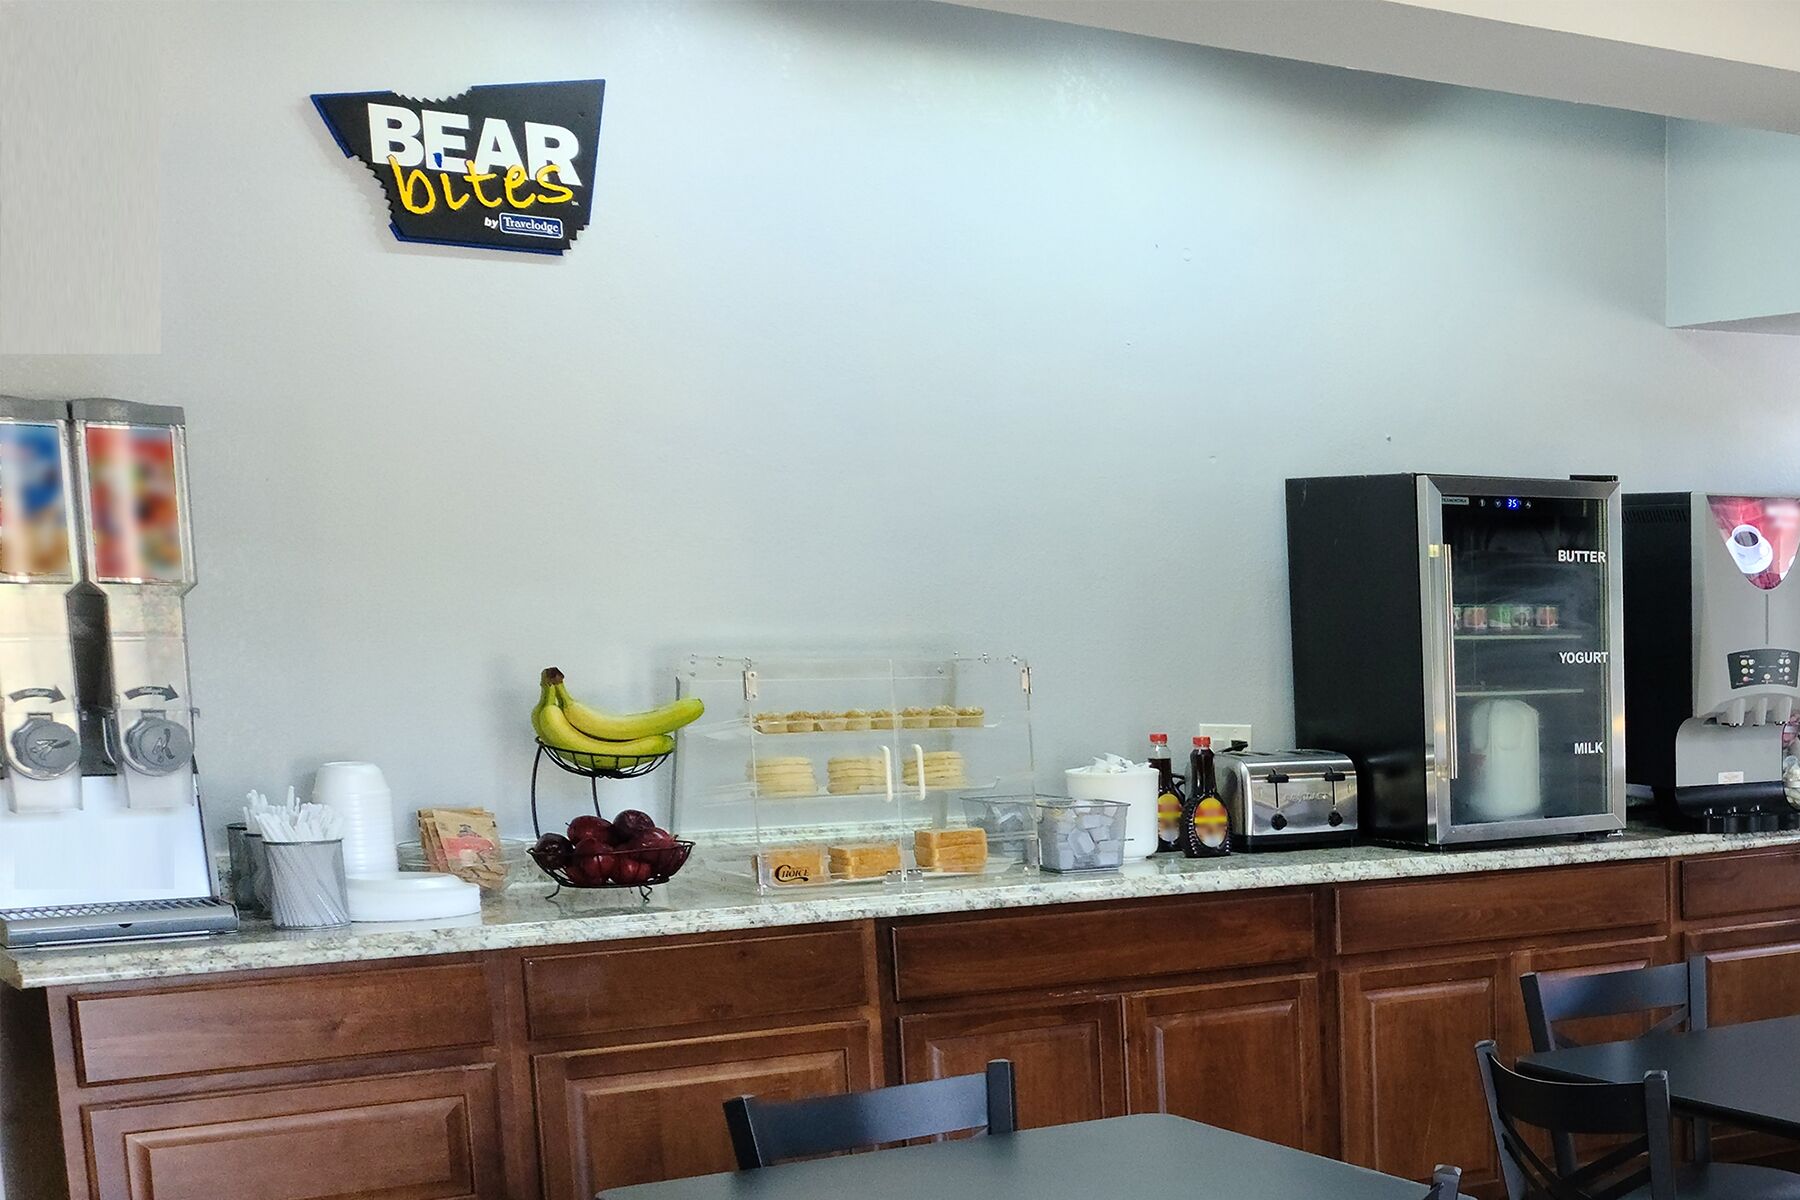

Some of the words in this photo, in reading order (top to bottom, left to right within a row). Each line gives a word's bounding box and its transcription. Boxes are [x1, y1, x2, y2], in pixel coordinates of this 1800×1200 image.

[367, 103, 583, 187] BEAR
[387, 154, 574, 215] bites
[484, 216, 499, 229] by
[502, 216, 559, 235] Travelodge
[1508, 499, 1517, 508] 35
[1558, 549, 1607, 564] BUTTER
[1559, 651, 1608, 664] YOGURT
[1574, 742, 1605, 754] MILK
